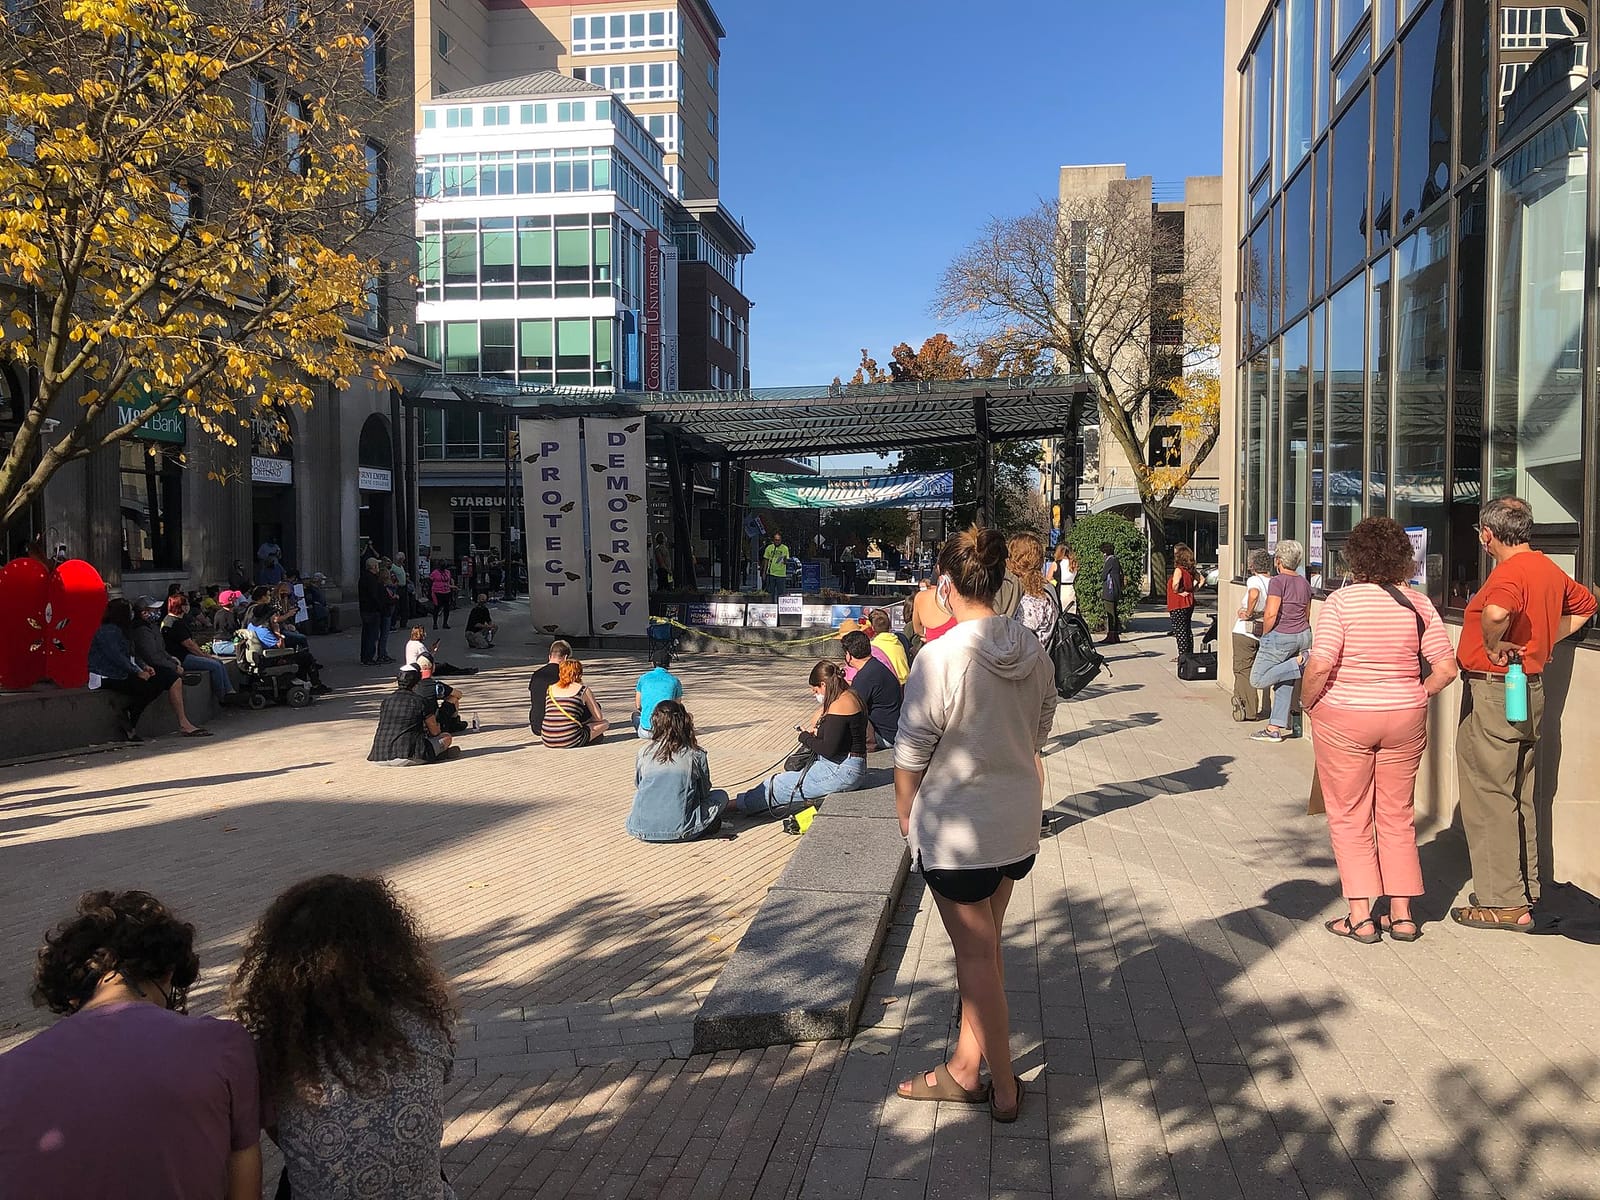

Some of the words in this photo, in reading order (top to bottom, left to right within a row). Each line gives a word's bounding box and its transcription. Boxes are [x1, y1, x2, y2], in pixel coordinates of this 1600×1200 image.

[647, 245, 660, 322] UNIVERSITY
[647, 330, 660, 390] CORNELL
[152, 411, 182, 433] Bank
[541, 442, 566, 596] PROTECT
[607, 432, 632, 615] DEMOCRACY
